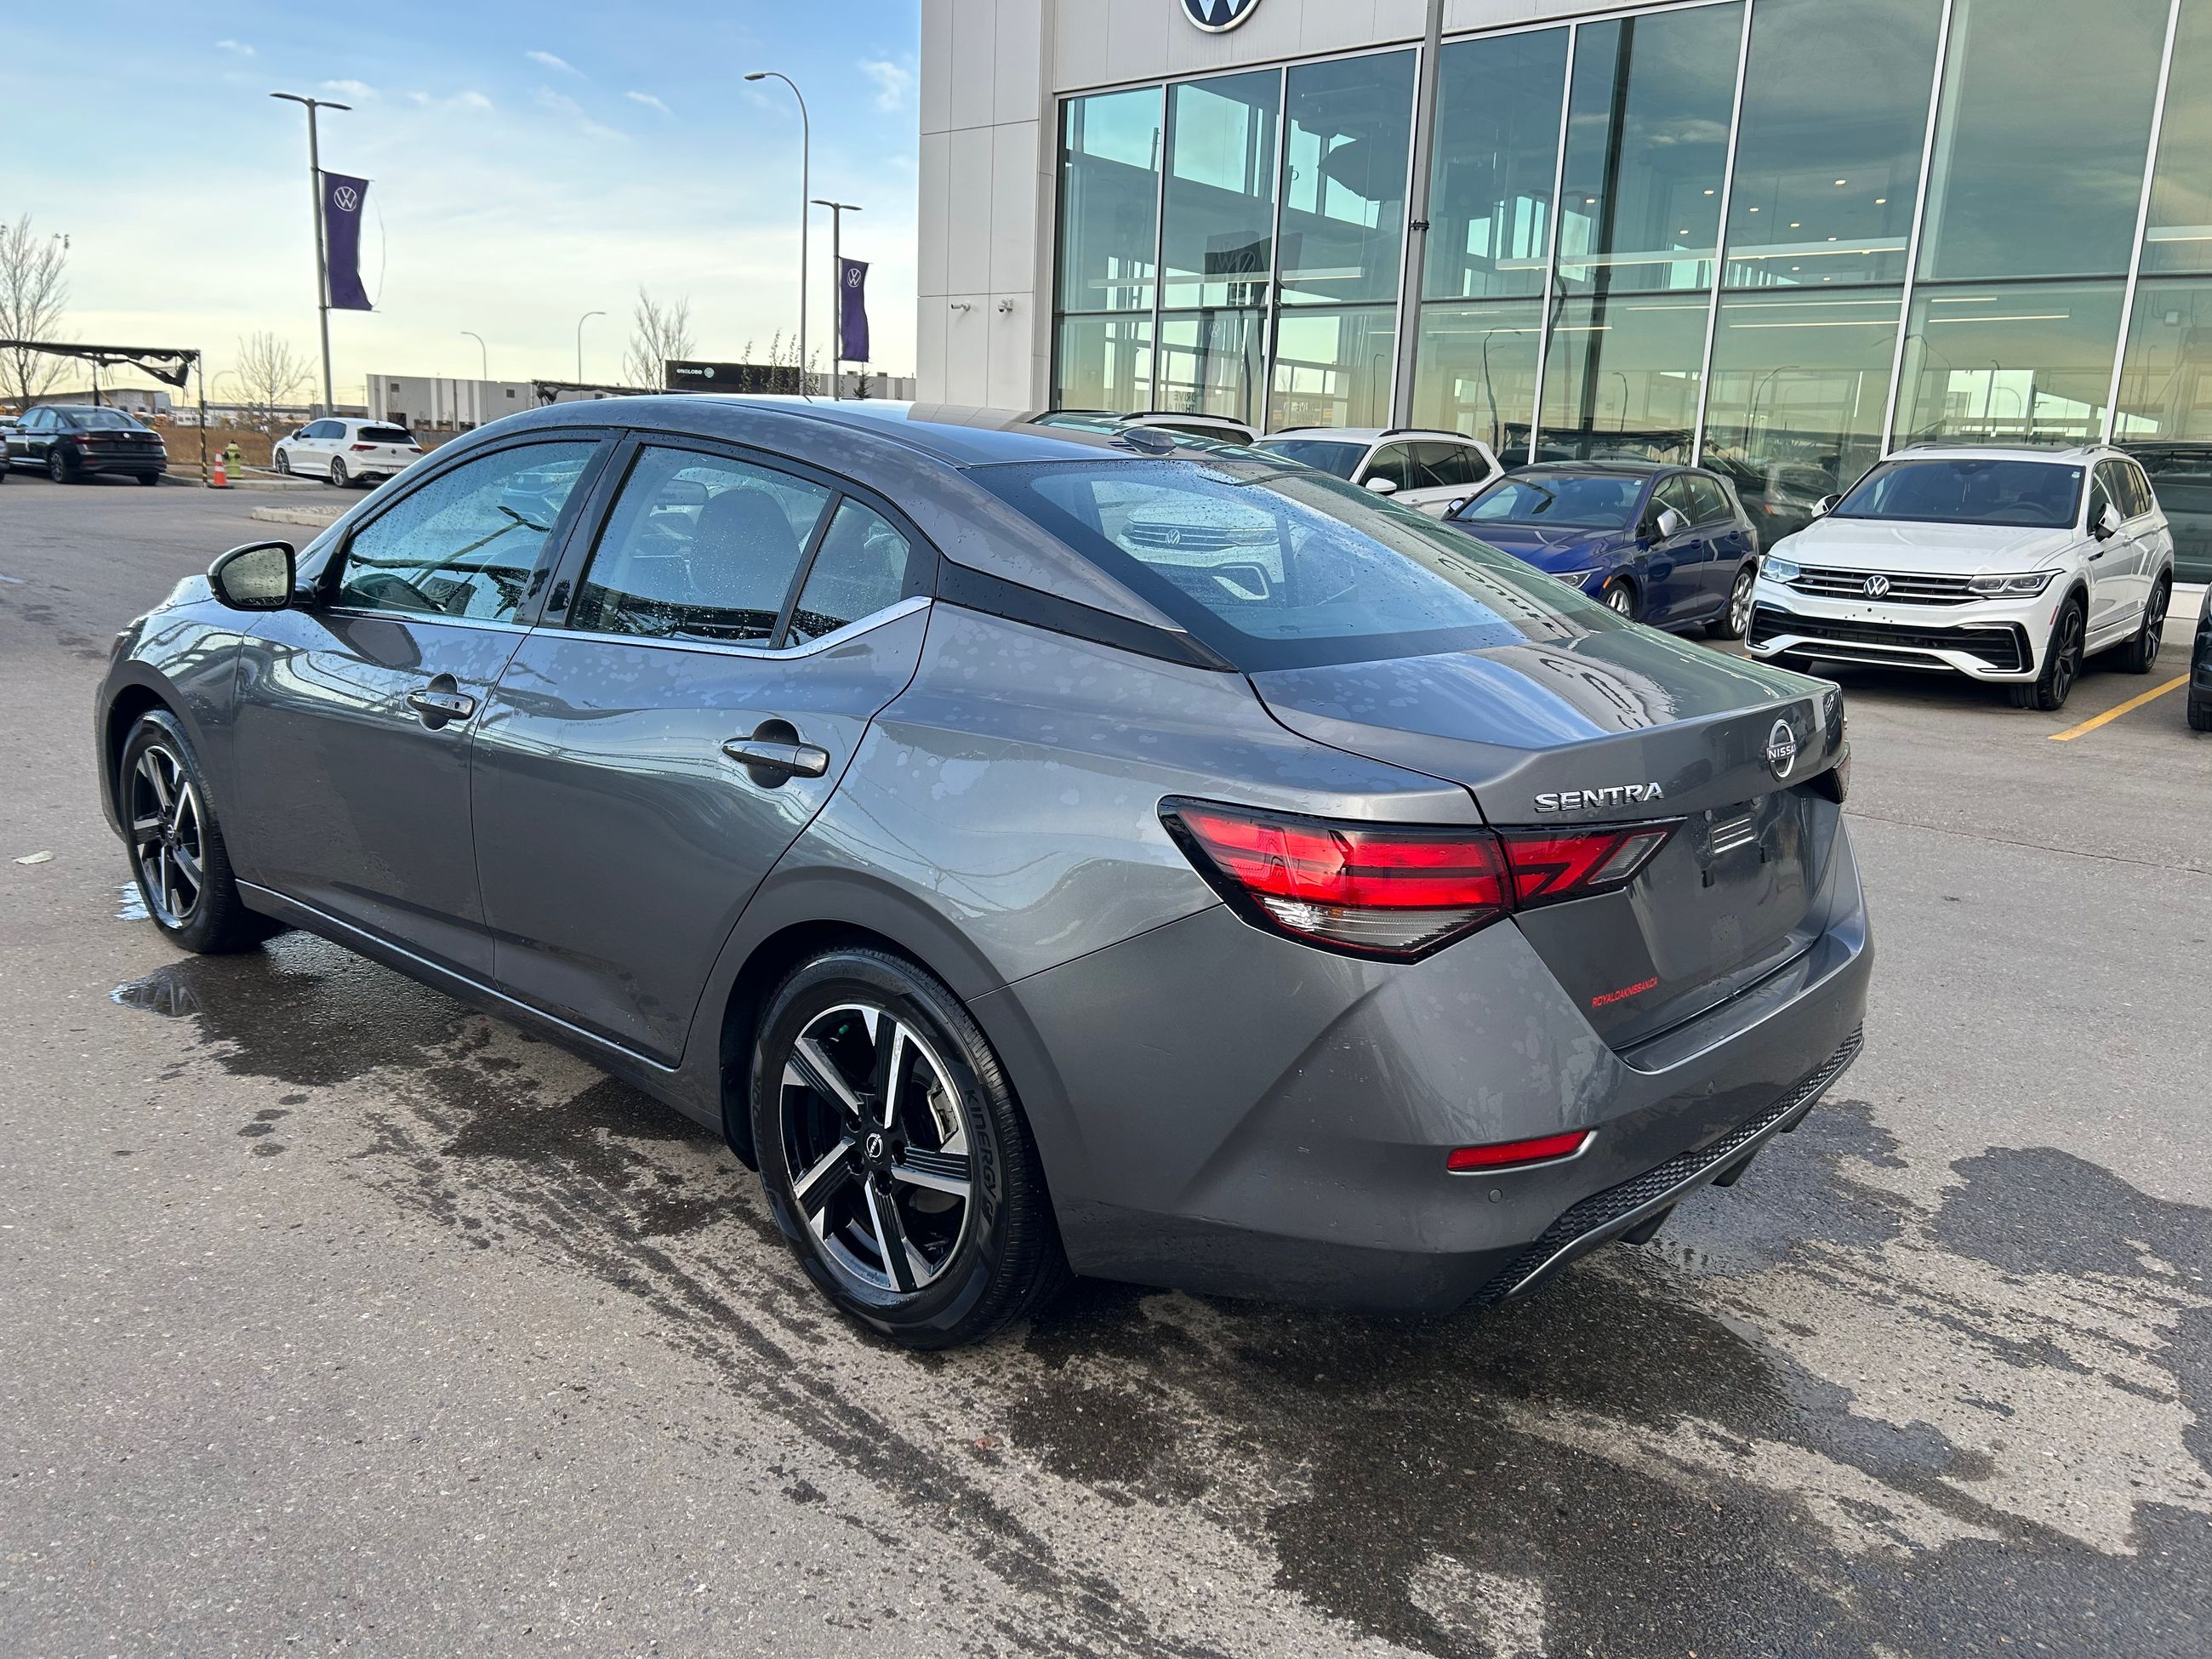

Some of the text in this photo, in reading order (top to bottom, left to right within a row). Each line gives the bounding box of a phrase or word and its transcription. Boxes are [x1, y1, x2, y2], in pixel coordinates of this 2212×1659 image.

[334, 186, 357, 211] VW
[847, 268, 861, 288] VW
[1863, 575, 1890, 599] VW
[1535, 782, 1665, 812] SENTRA
[964, 1089, 996, 1199] KINERGY
